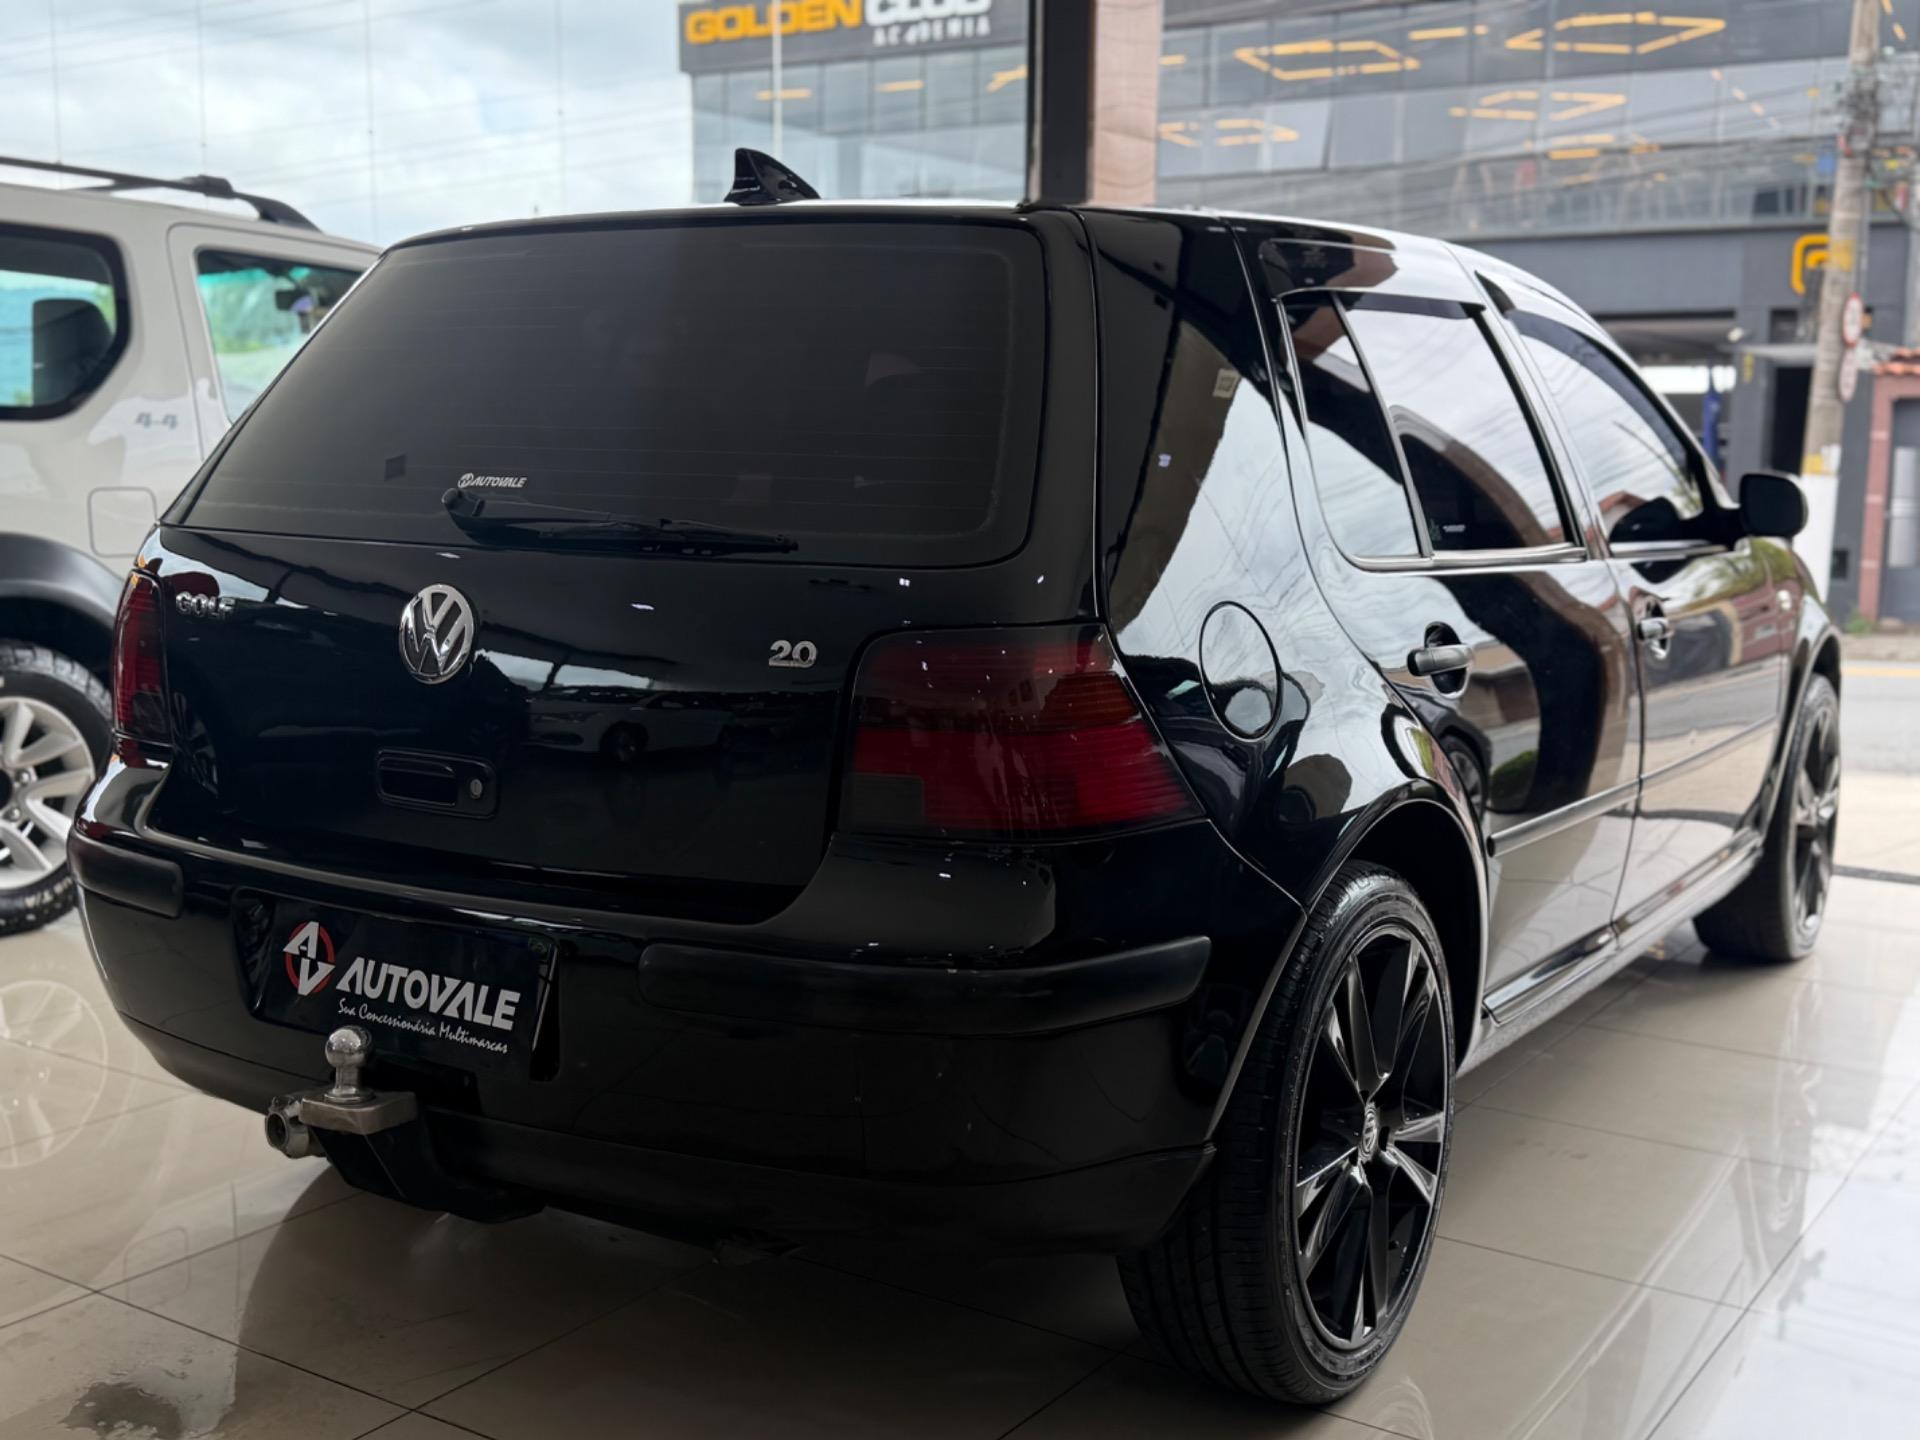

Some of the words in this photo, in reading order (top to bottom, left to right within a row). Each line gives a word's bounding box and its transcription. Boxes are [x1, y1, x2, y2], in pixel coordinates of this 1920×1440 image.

[685, 0, 862, 44] GOLDEN
[470, 475, 528, 488] AUTOVALE
[175, 591, 236, 619] GOLF
[336, 956, 522, 1031] AUTOVALE
[337, 997, 356, 1015] Sua
[439, 1021, 508, 1053] Multimarcas
